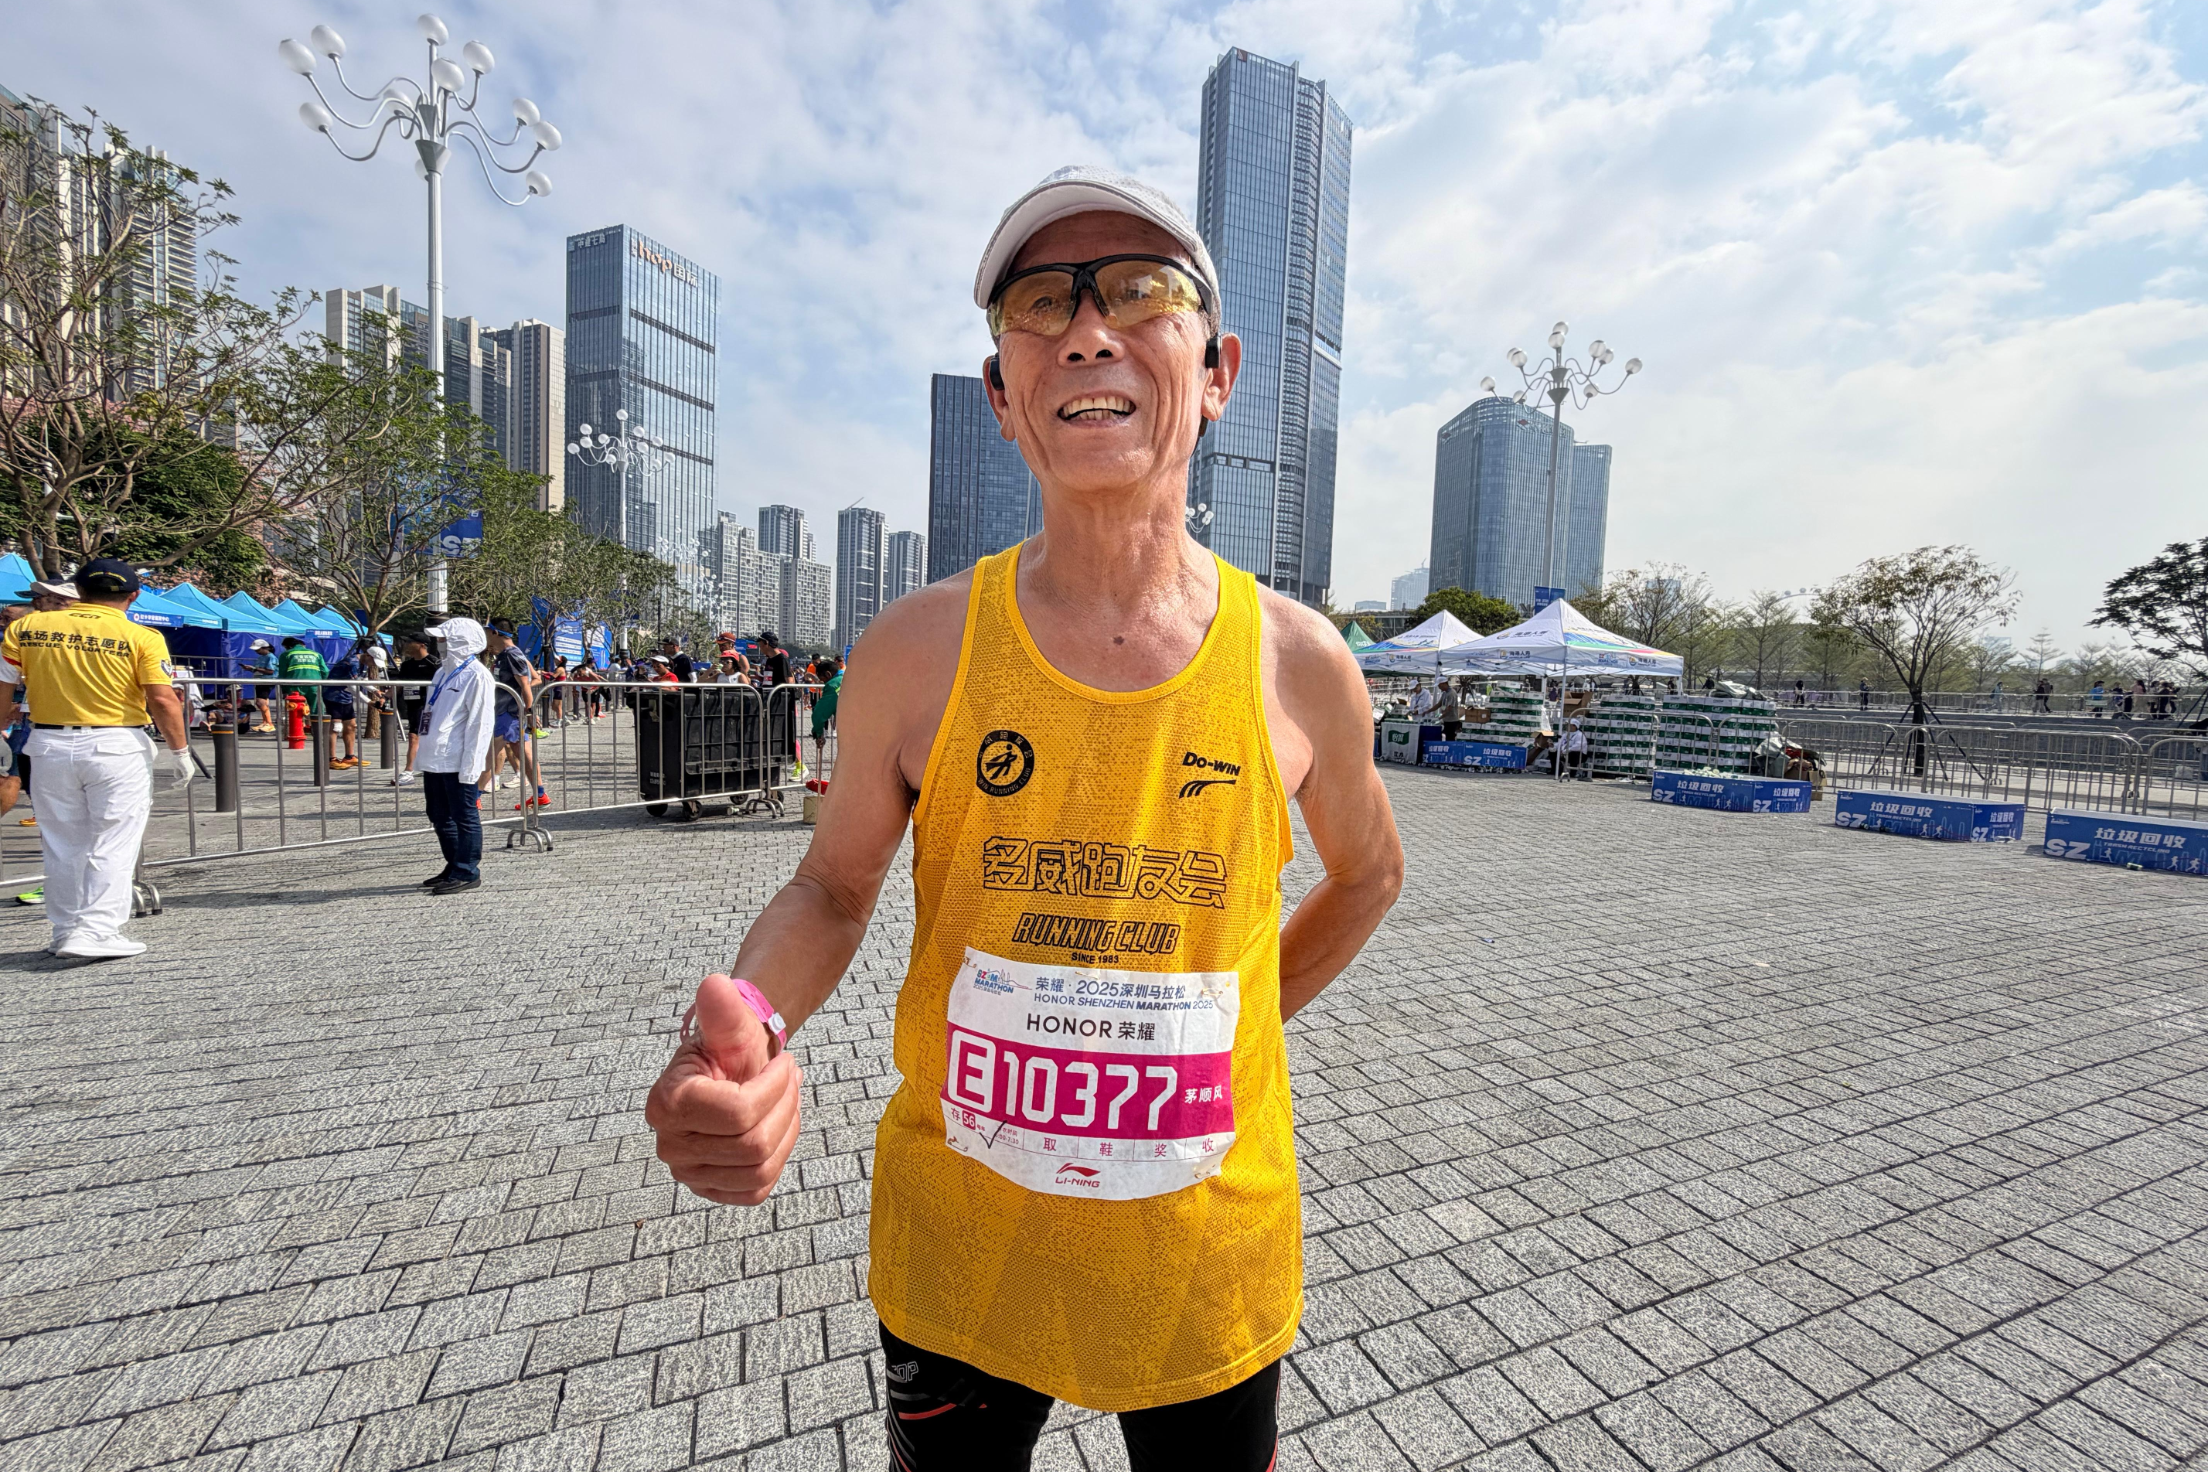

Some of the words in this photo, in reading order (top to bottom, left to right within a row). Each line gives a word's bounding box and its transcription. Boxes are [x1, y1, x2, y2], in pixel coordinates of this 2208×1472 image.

[19, 630, 132, 653] 赛场救护志愿队
[19, 641, 61, 649] RESCUE
[66, 644, 131, 658] VOLUNTEER
[1464, 755, 1482, 766] SZ
[1676, 780, 1725, 793] 垃圾回收
[1773, 788, 1801, 797] 垃圾回收
[1652, 788, 1675, 802] SZ
[1753, 799, 1772, 813] SZ
[1870, 802, 1934, 818] 垃圾回收
[1835, 811, 1867, 828] SZ
[1990, 812, 2014, 823] 垃圾回收
[1971, 826, 1989, 842] SZ
[2094, 827, 2187, 849] 垃圾回收
[2044, 838, 2091, 860] SZ
[2103, 841, 2128, 850] TRASH
[983, 836, 1227, 910] 多威跑友会
[1011, 911, 1115, 953] RUNNING
[1116, 920, 1181, 954] CLUB
[1071, 951, 1095, 964] SINCE
[1098, 953, 1119, 964] 1983
[974, 978, 1014, 994] MARATHON
[1034, 993, 1075, 1006] HONOR
[1077, 997, 1135, 1010] SHENZHEN
[1136, 1001, 1191, 1011] MARATHON
[1193, 1000, 1213, 1010] 2025
[1027, 1013, 1112, 1038] HONOR
[1118, 1021, 1155, 1041] 荣耀
[948, 1030, 1178, 1131] E10377
[1184, 1088, 1223, 1104] 茅顺风
[963, 1112, 975, 1128] 56
[1043, 1138, 1057, 1153] 取
[1099, 1141, 1113, 1157] 鞋
[1154, 1142, 1167, 1158] 奖
[1201, 1138, 1214, 1153] 收
[1055, 1176, 1100, 1189] LI-NING
